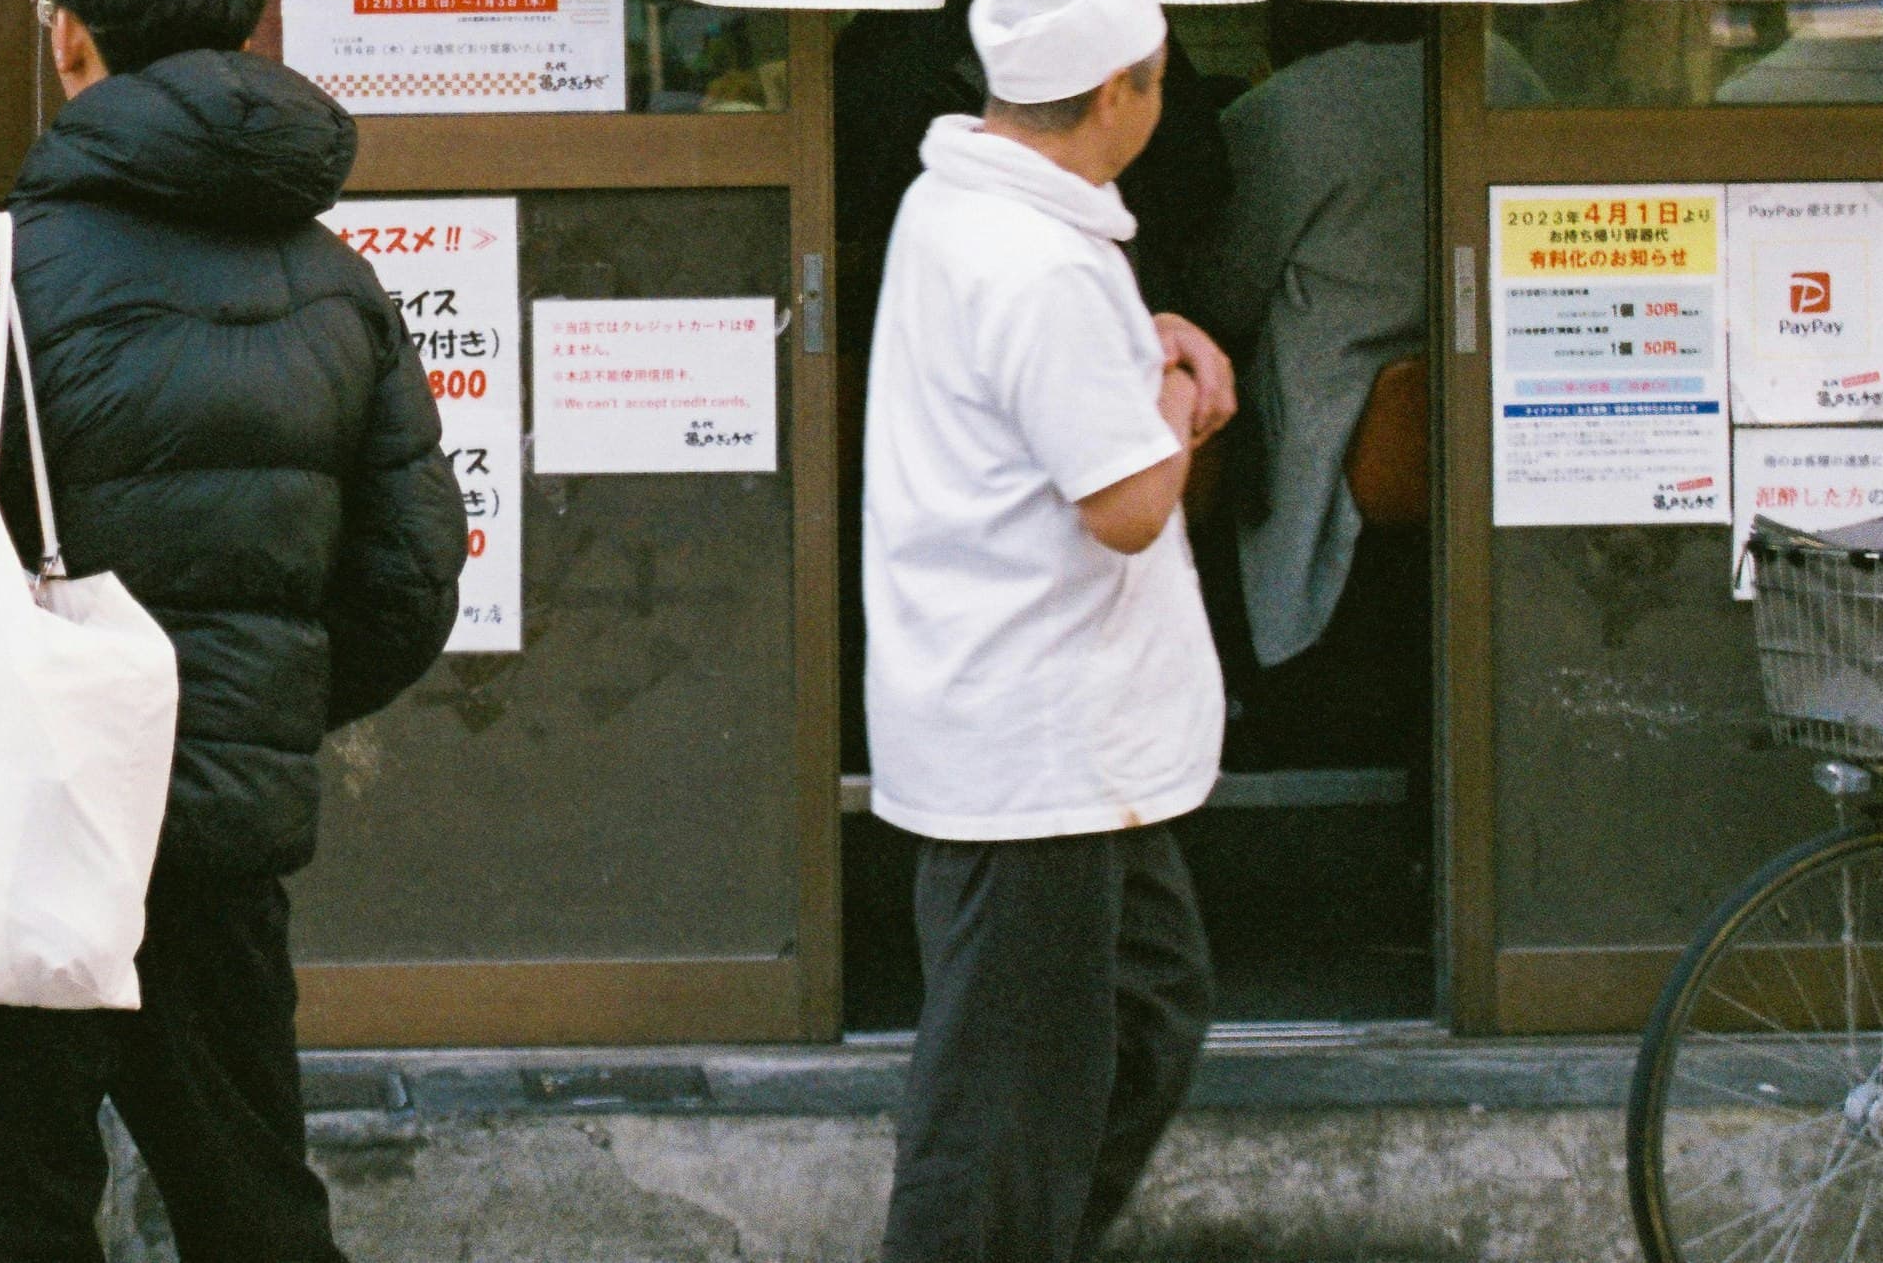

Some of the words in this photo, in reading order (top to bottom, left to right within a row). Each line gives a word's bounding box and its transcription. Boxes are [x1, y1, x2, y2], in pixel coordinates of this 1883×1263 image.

[1529, 247, 1687, 269] 有料化のお知らせ
[1779, 319, 1844, 335] PayPay
[428, 370, 487, 399] 800
